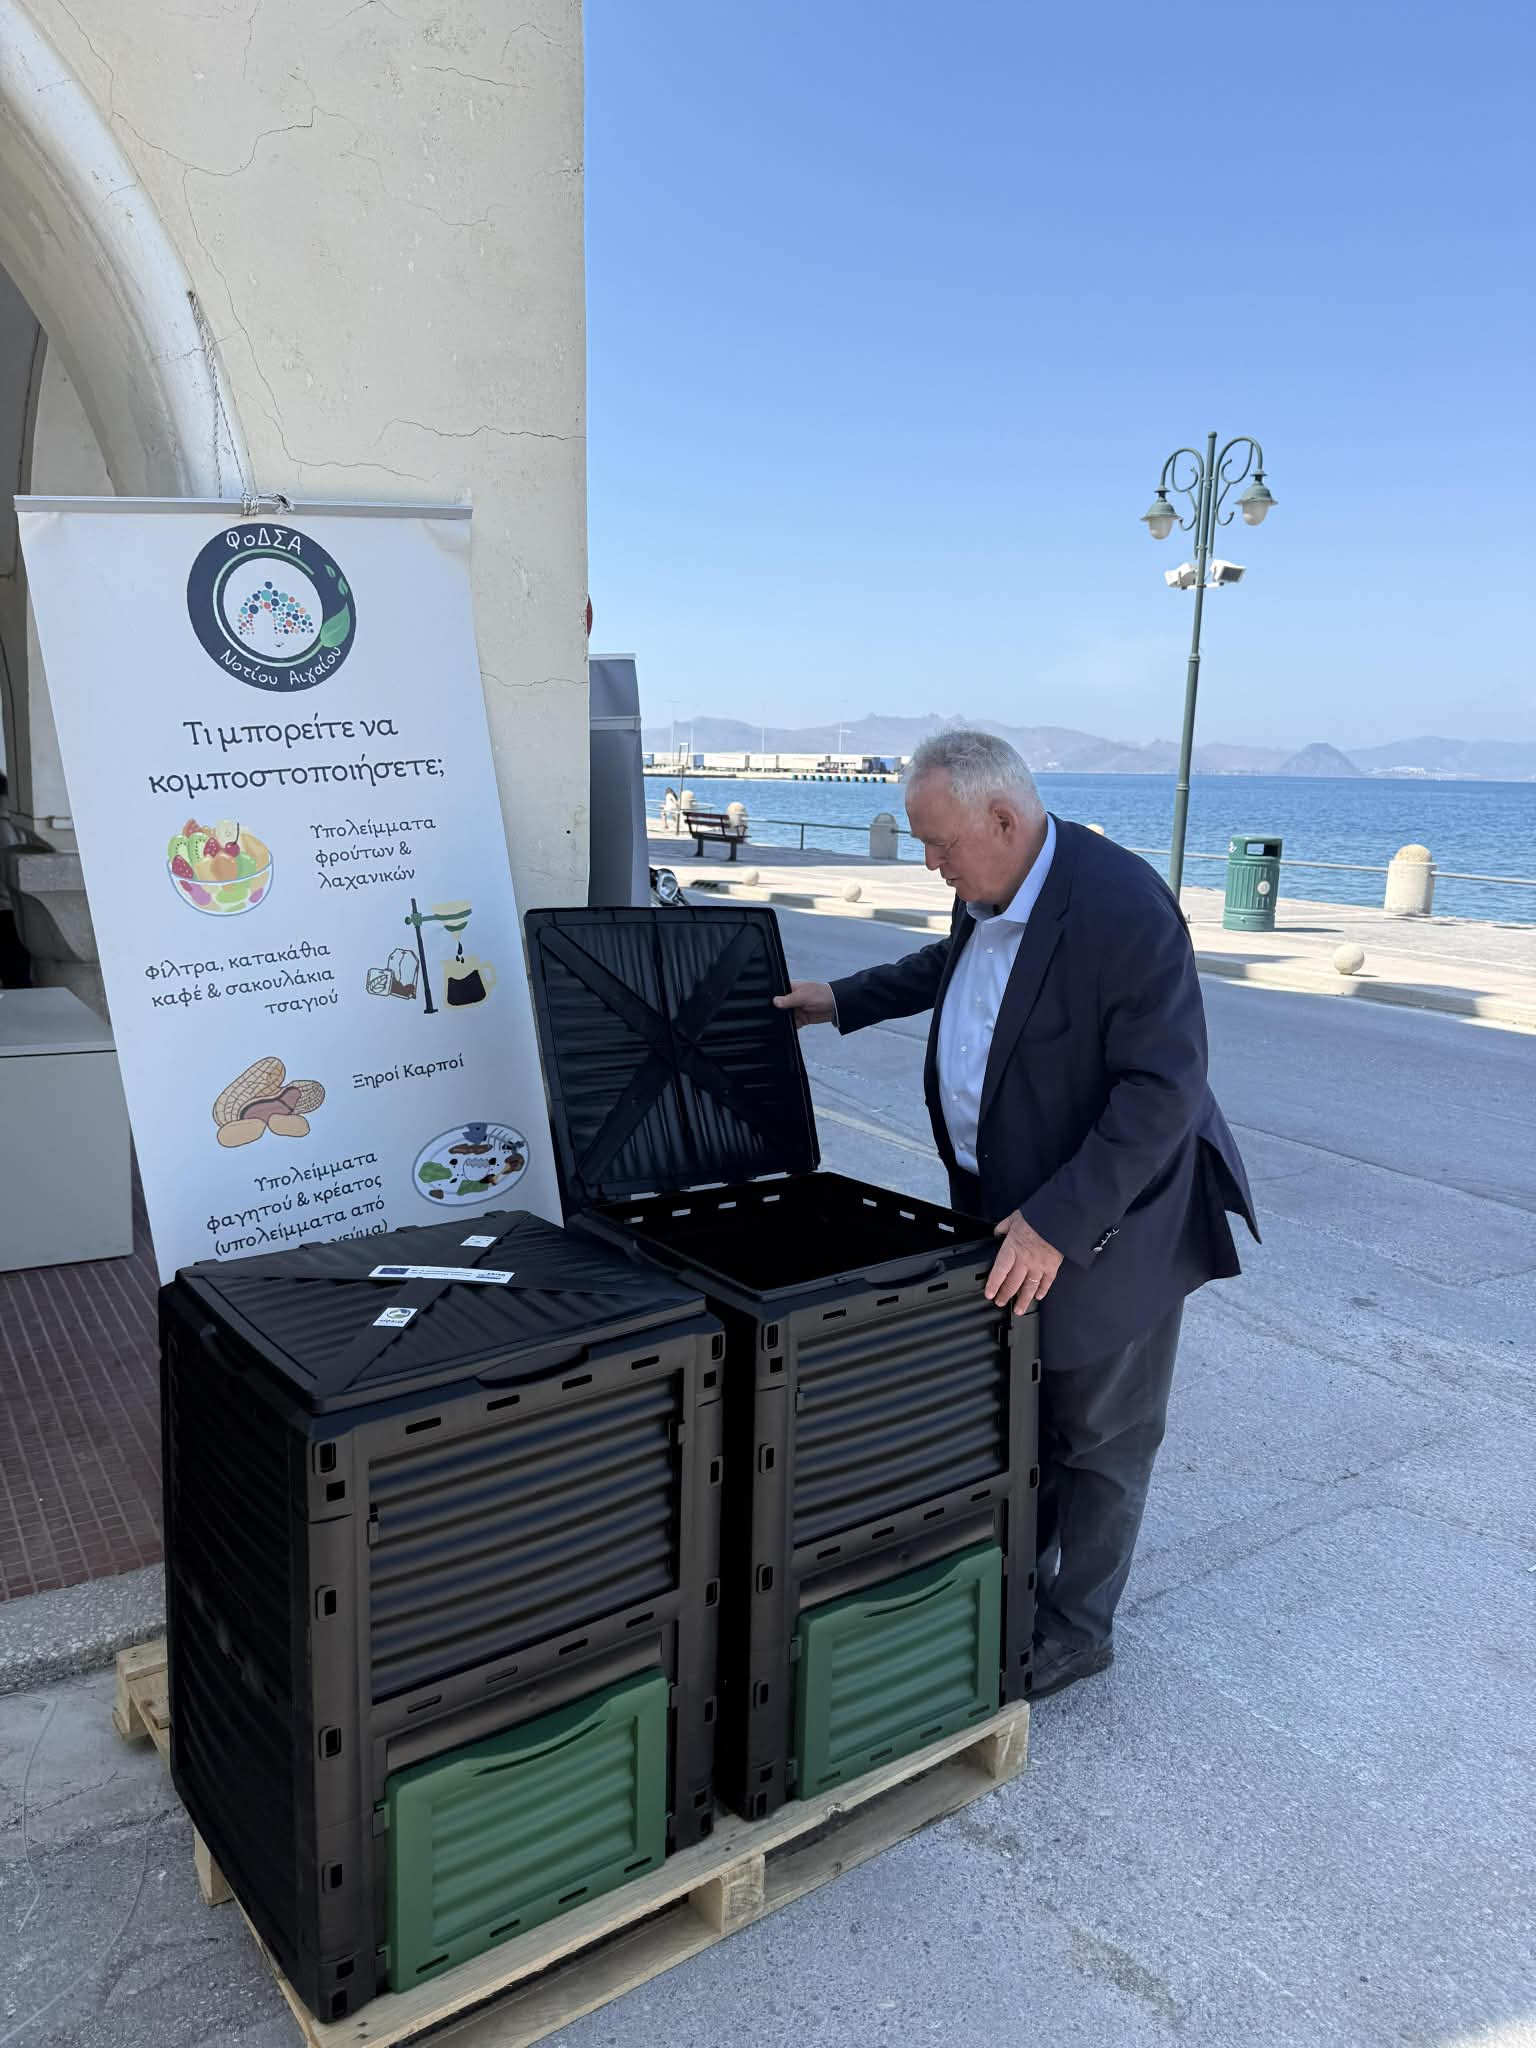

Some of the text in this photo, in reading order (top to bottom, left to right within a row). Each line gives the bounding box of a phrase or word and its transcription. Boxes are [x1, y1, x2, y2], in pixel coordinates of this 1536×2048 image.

[226, 528, 302, 555] ΦοΔΣΑ
[220, 647, 342, 685] Νοτίου Αιγαίου
[183, 713, 399, 752] Τι μπορείτε να
[149, 754, 445, 799] κομποστοποιήσετε;
[310, 818, 436, 839] Υπολείμματα
[315, 841, 412, 868] φρούτων &
[317, 865, 415, 890] λαχανικών
[145, 941, 331, 980] Φίλτρα, κατακάθια
[152, 969, 335, 1007] καφέ & σακουλάκια
[264, 988, 339, 1014] τσαγιού
[352, 1052, 464, 1089] Ξηροί Καρποί
[254, 1152, 378, 1192] Υπολείμματα
[206, 1175, 382, 1234] φαγητού & κρέατος
[215, 1196, 385, 1256] (υπολείμματα από
